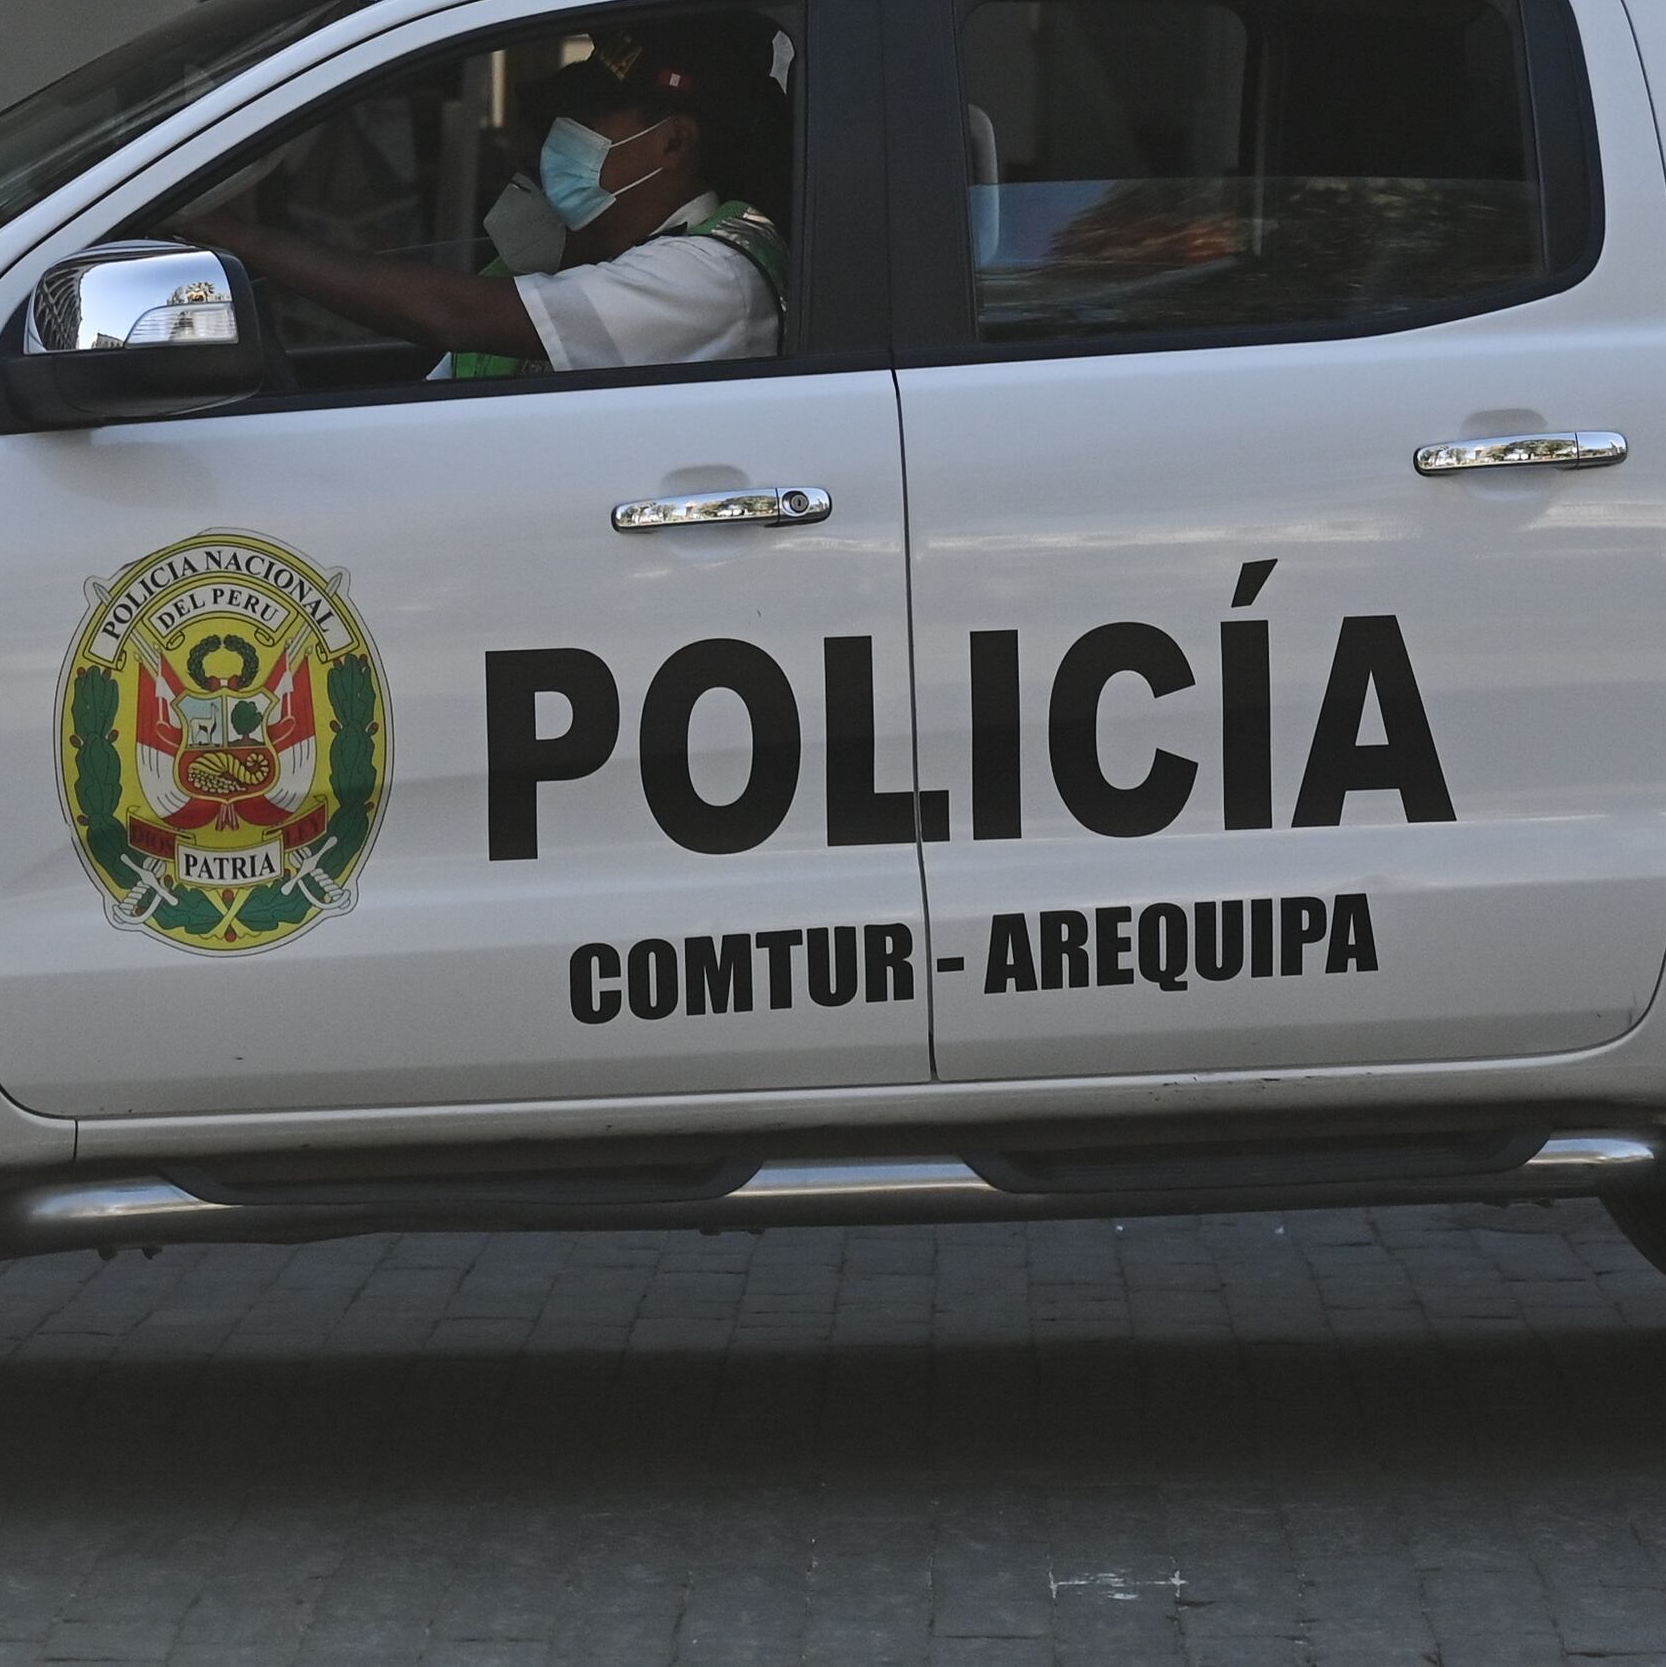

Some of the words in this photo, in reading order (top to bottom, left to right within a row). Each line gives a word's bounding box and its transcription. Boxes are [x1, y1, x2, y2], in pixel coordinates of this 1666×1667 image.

[102, 556, 200, 641] POLICIA
[205, 549, 334, 634] NACIONAL
[156, 591, 207, 630] DEL
[211, 587, 279, 623] PERU
[484, 558, 1458, 861] POLICÍA
[183, 851, 276, 881] PATRIA
[568, 922, 916, 1025] COMTUR
[982, 892, 1380, 996] AREQUIPA
